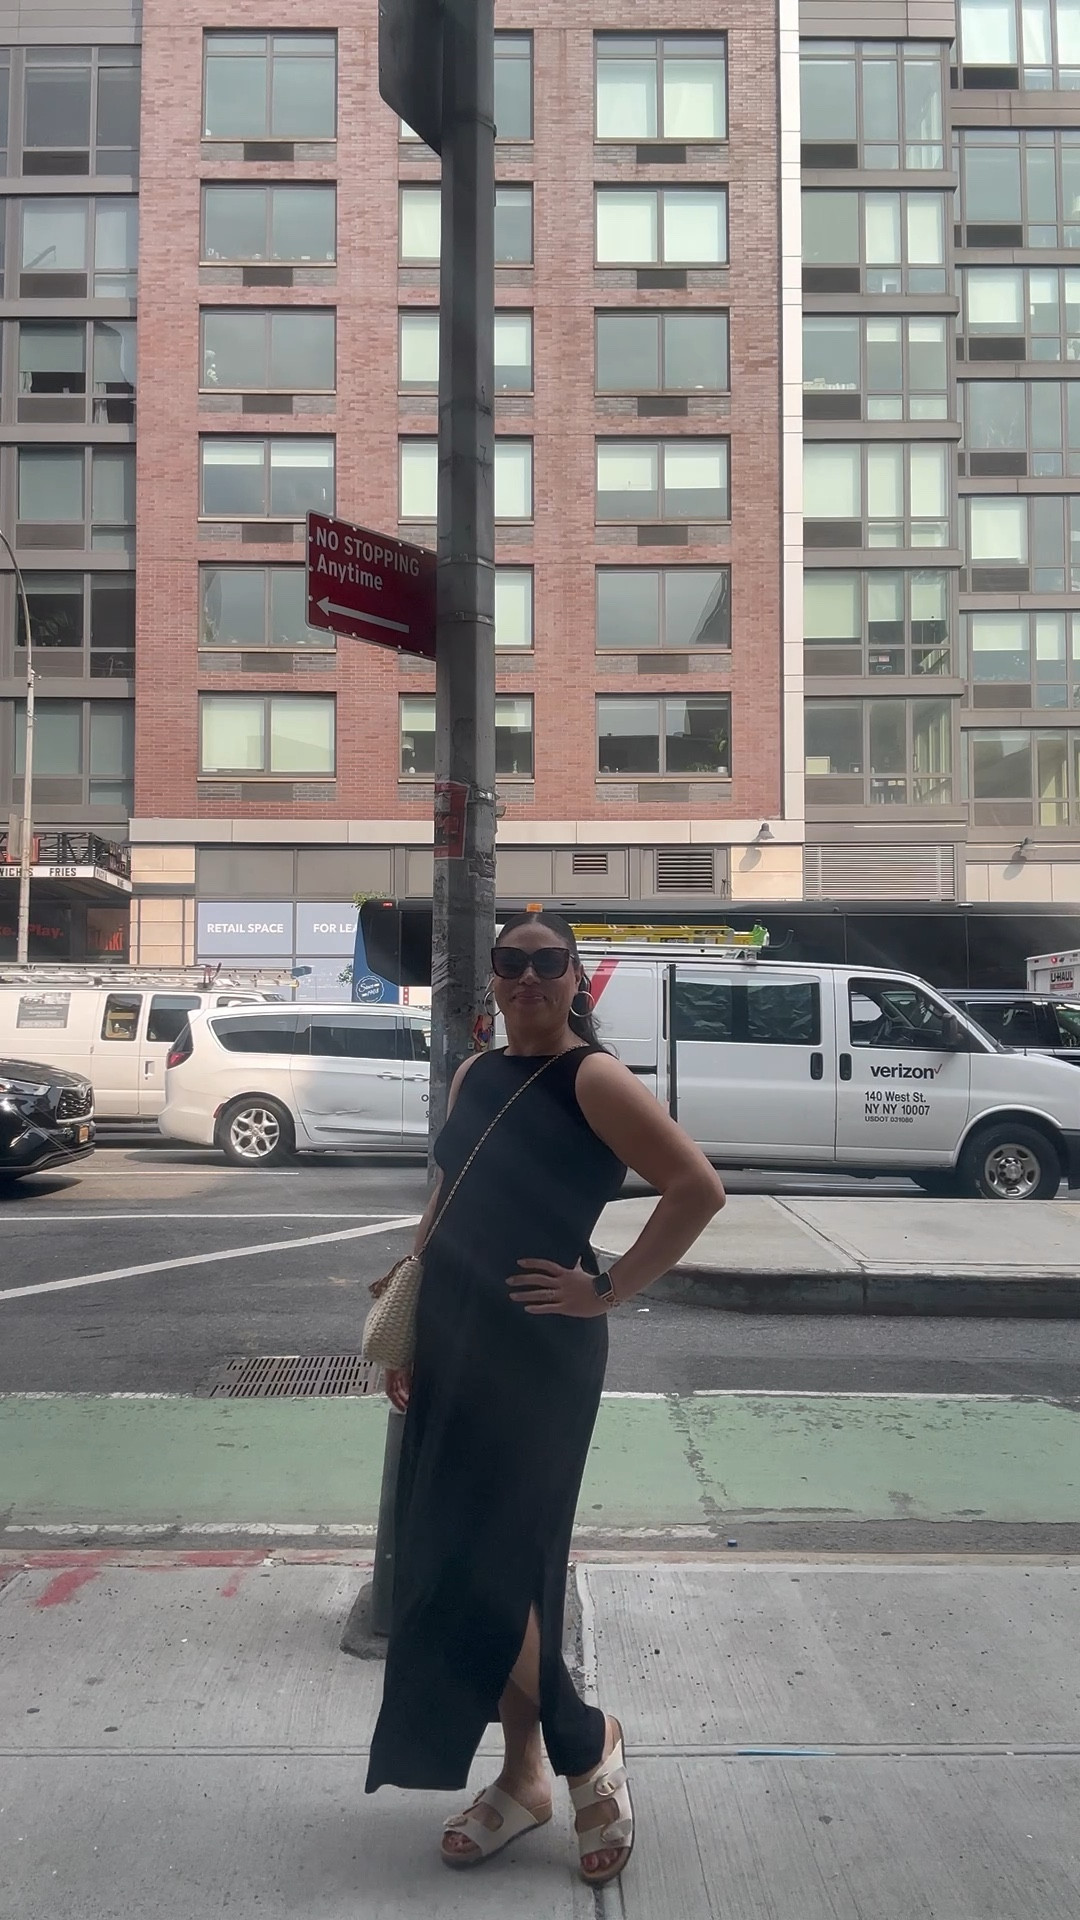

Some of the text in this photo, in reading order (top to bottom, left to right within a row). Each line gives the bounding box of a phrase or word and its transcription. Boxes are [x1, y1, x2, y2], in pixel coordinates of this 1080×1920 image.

[316, 526, 420, 577] NO STOPPING
[317, 553, 383, 591] Anytime
[49, 867, 77, 877] FRIES
[207, 923, 284, 933] RETAIL SPACE
[313, 923, 336, 933] FOR
[870, 1063, 934, 1079] verizon
[865, 1091, 927, 1103] 140 West St.
[865, 1103, 931, 1116] NY NY 10007
